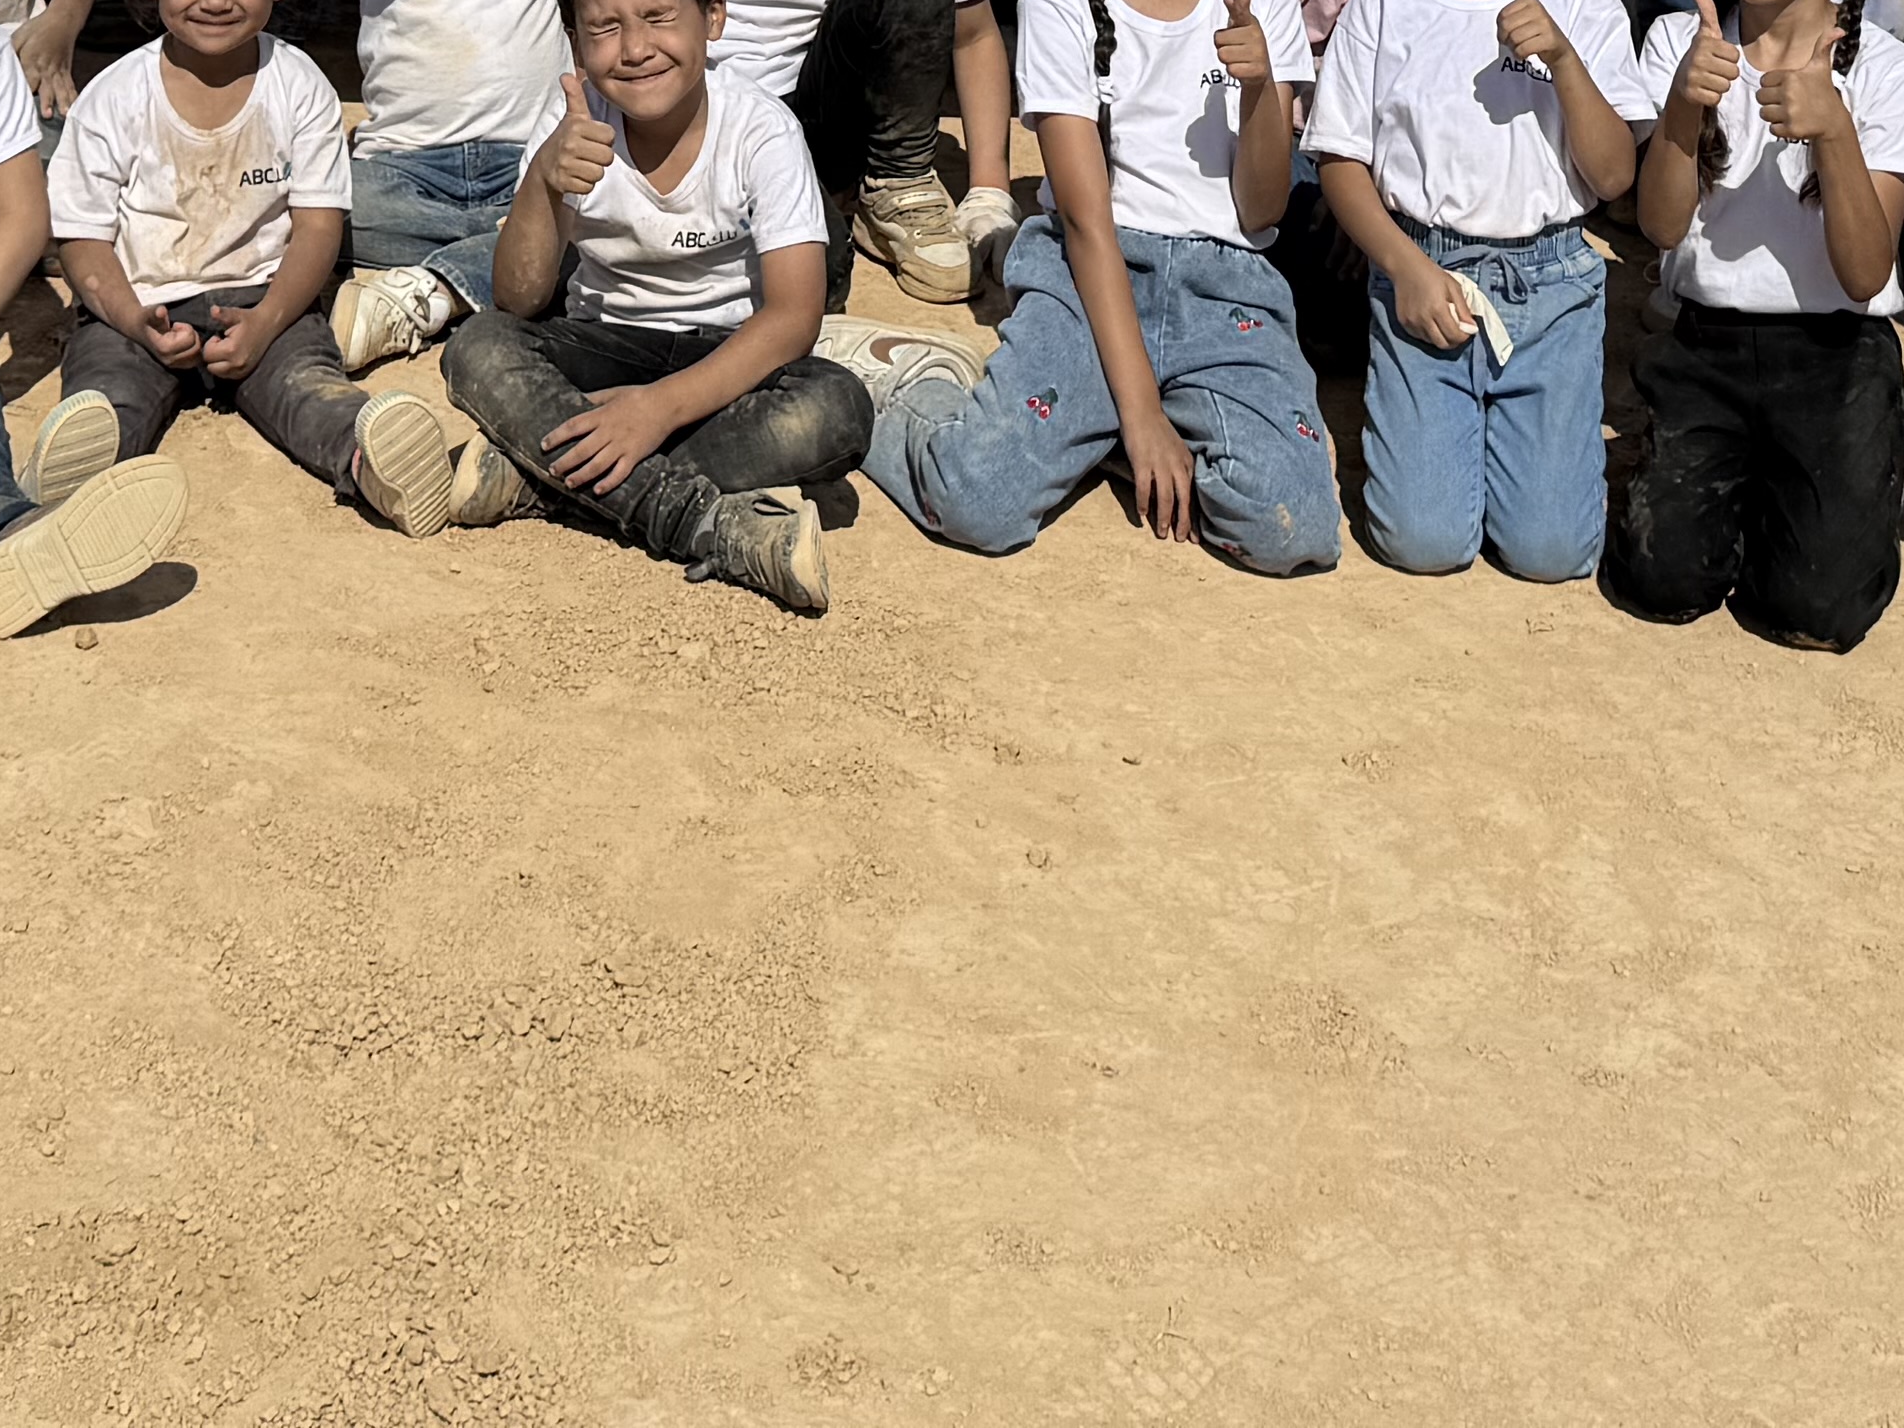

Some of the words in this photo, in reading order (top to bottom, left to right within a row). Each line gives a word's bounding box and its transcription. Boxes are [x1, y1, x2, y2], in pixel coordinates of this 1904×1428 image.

[1200, 69, 1223, 89] AB
[239, 168, 274, 188] ABC
[671, 231, 707, 248] ABC
